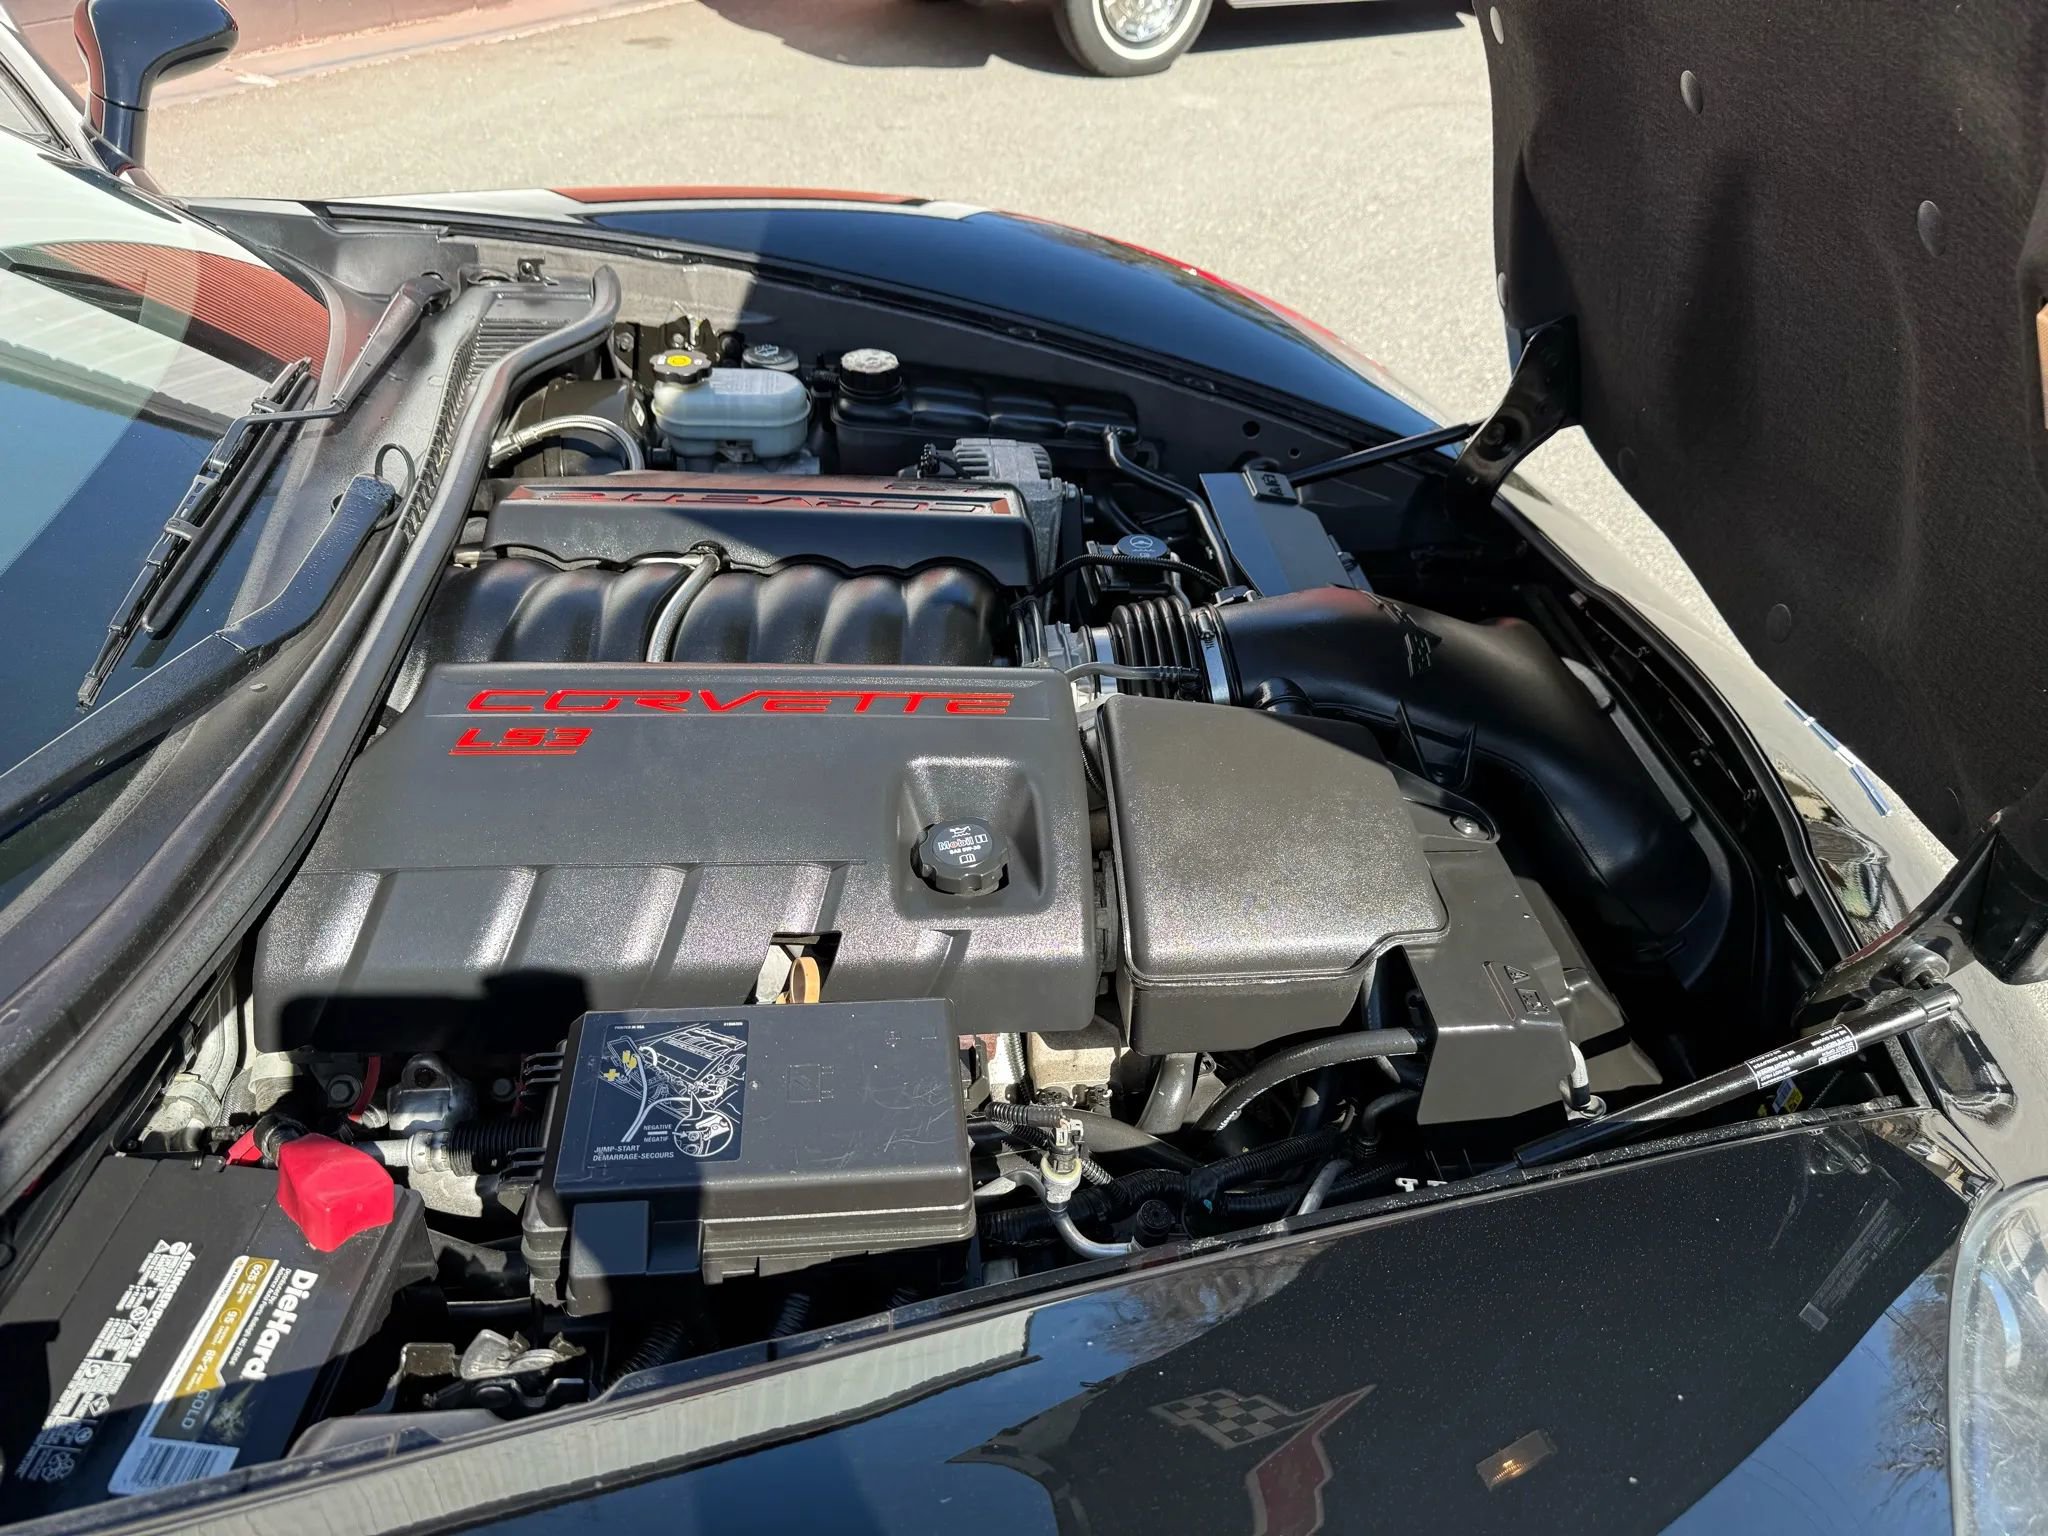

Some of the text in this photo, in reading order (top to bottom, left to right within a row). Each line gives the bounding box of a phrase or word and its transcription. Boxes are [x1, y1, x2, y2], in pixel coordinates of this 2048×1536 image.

[466, 689, 1014, 714] CORVETTE
[455, 727, 592, 748] LS3
[938, 836, 974, 851] Mobil
[594, 1145, 640, 1153] JUMP-START
[240, 1269, 318, 1380] DieHard
[181, 1388, 210, 1430] GOLD
